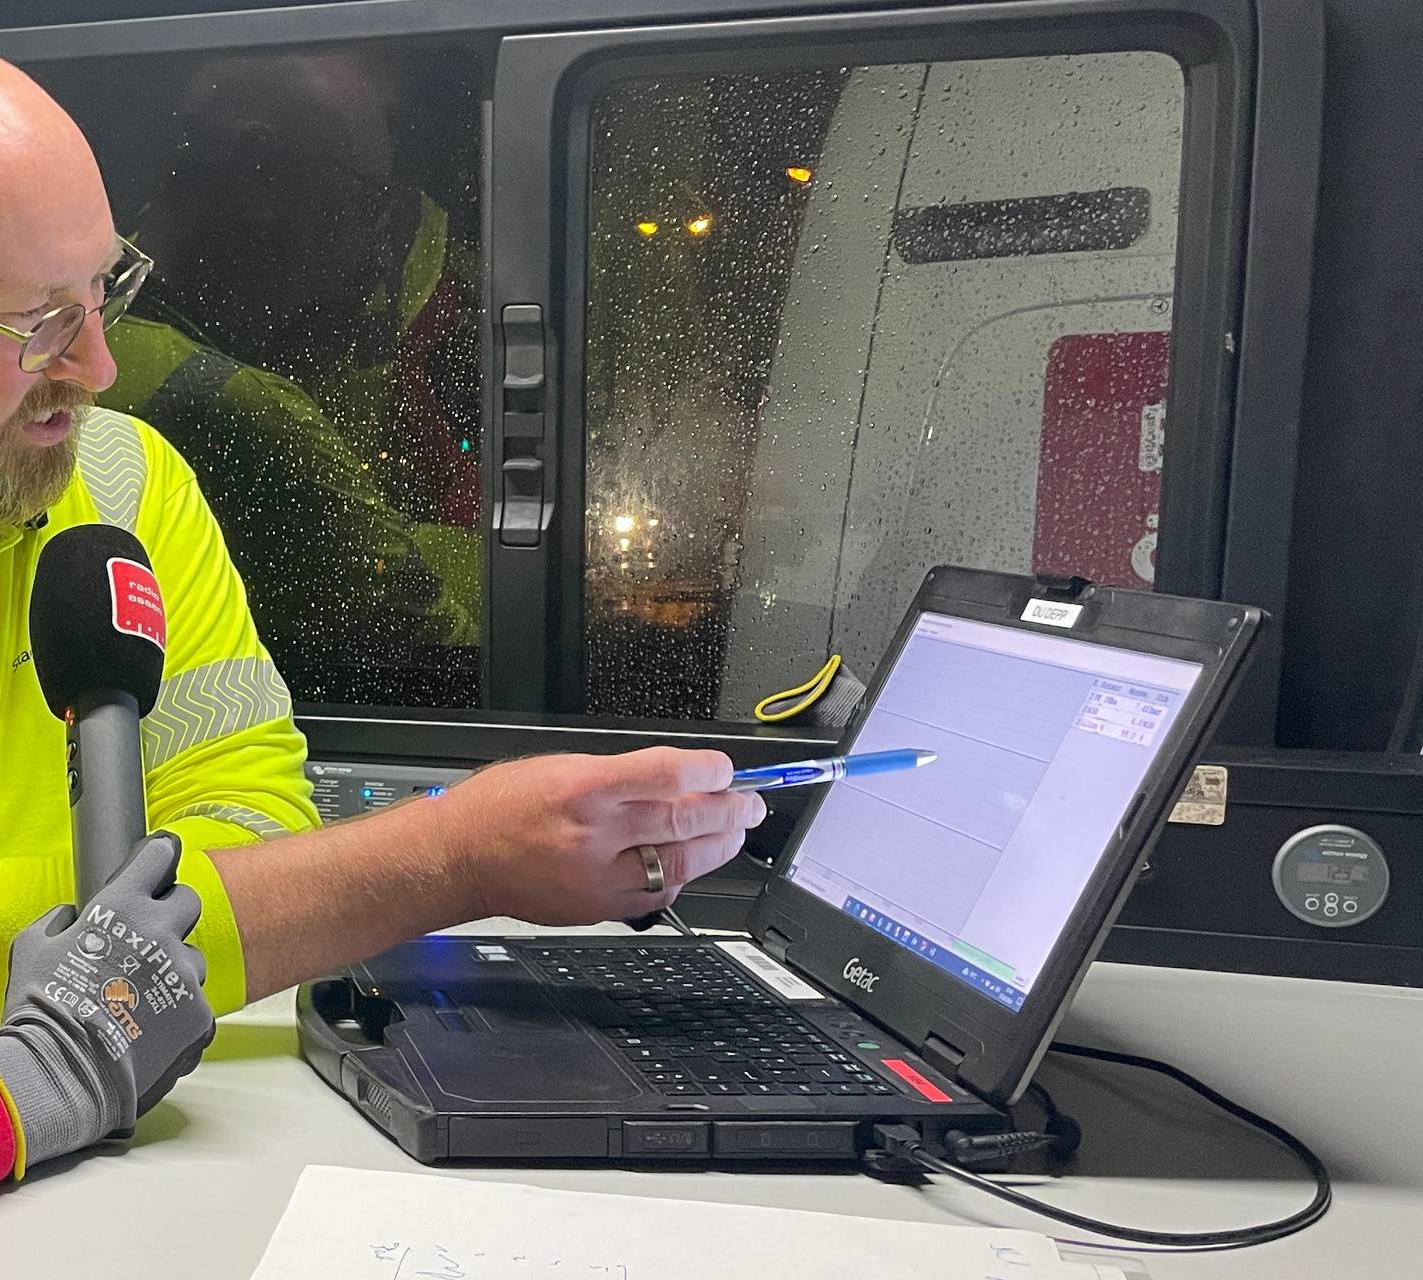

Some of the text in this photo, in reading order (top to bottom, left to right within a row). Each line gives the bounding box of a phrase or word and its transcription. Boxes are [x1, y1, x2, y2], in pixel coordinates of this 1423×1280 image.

[129, 581, 160, 602] radio
[128, 594, 163, 617] essen
[86, 904, 190, 1002] MaxiFlex
[843, 957, 880, 993] Getac
[44, 981, 67, 1002] CE
